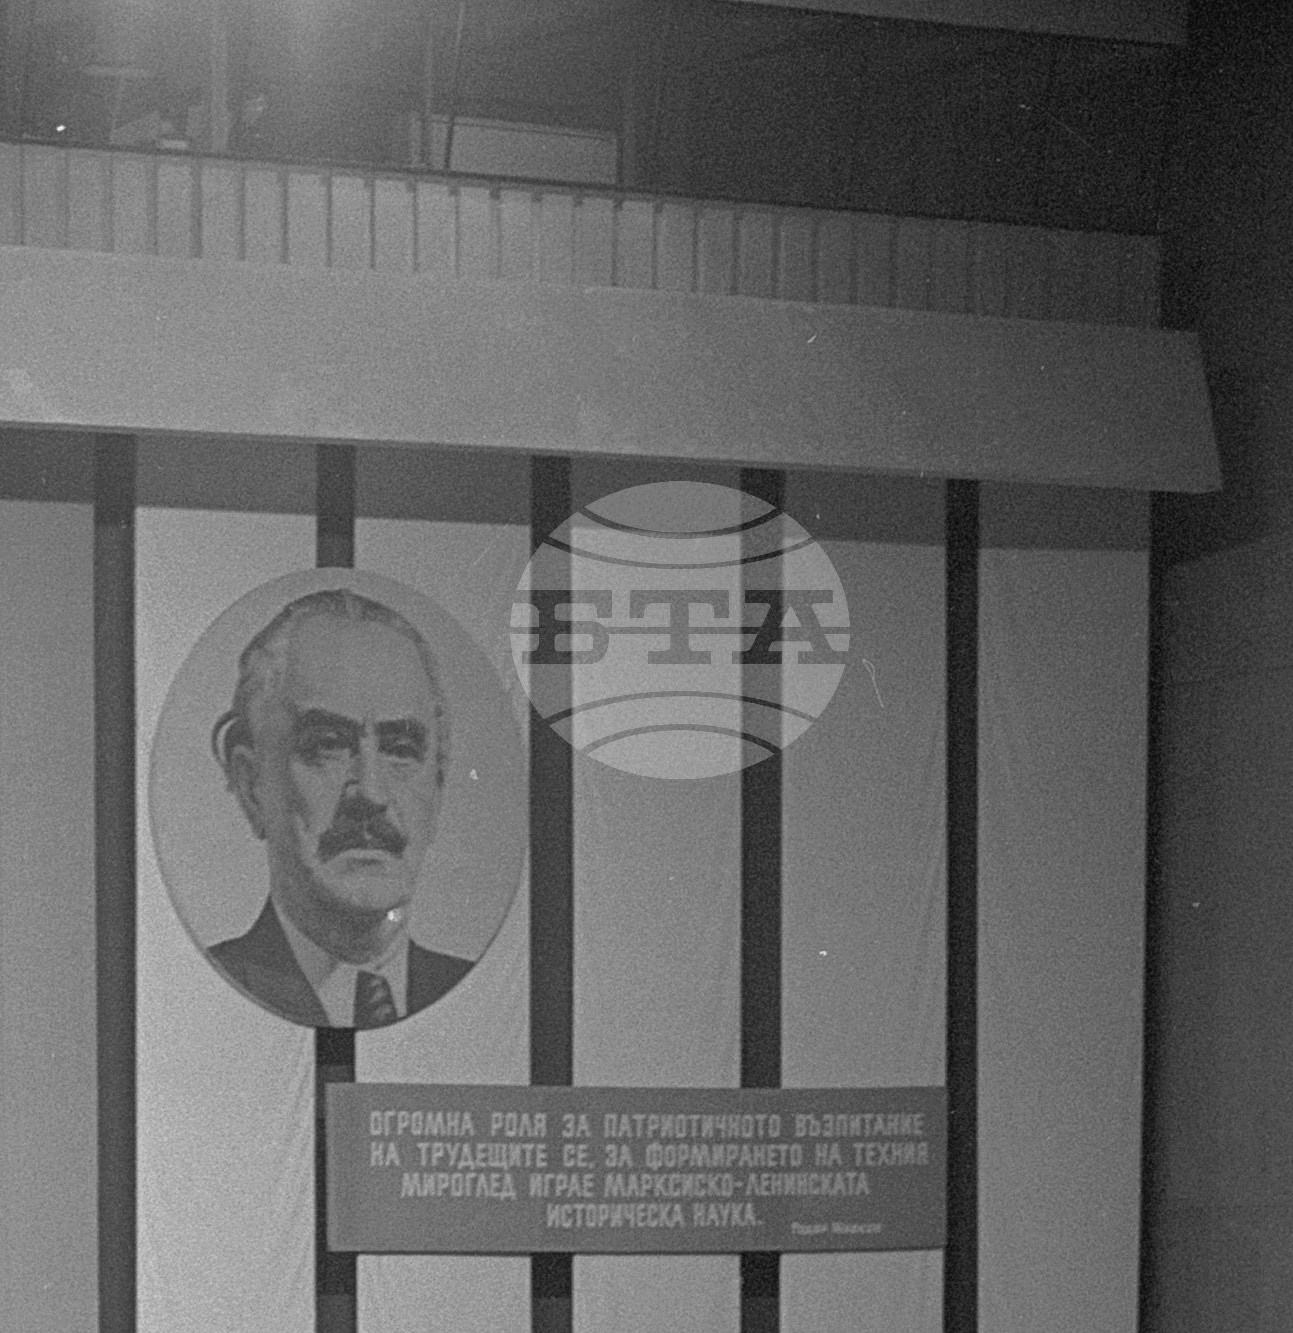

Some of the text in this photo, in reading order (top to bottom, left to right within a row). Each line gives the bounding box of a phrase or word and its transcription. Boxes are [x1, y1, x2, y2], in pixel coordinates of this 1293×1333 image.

[369, 1110, 926, 1138] ОГРОМНА РОЛЯ ЗА ПАТРИОТИЧНОТО ВЪЗПИТАНИЕ
[370, 1141, 401, 1167] НА
[416, 1141, 548, 1170] ТРУДЕЩИТЕ
[604, 1143, 633, 1168] ЗА
[645, 1141, 804, 1171] ФОРМИРАНЕТО
[815, 1142, 843, 1168] НА
[852, 1141, 929, 1167] ТЕХНИЯ
[400, 1172, 517, 1200] МИРОГЛЕД
[529, 1172, 595, 1197] ИГРАЕ
[546, 1202, 685, 1229] ИСТОРИЧЕСКА
